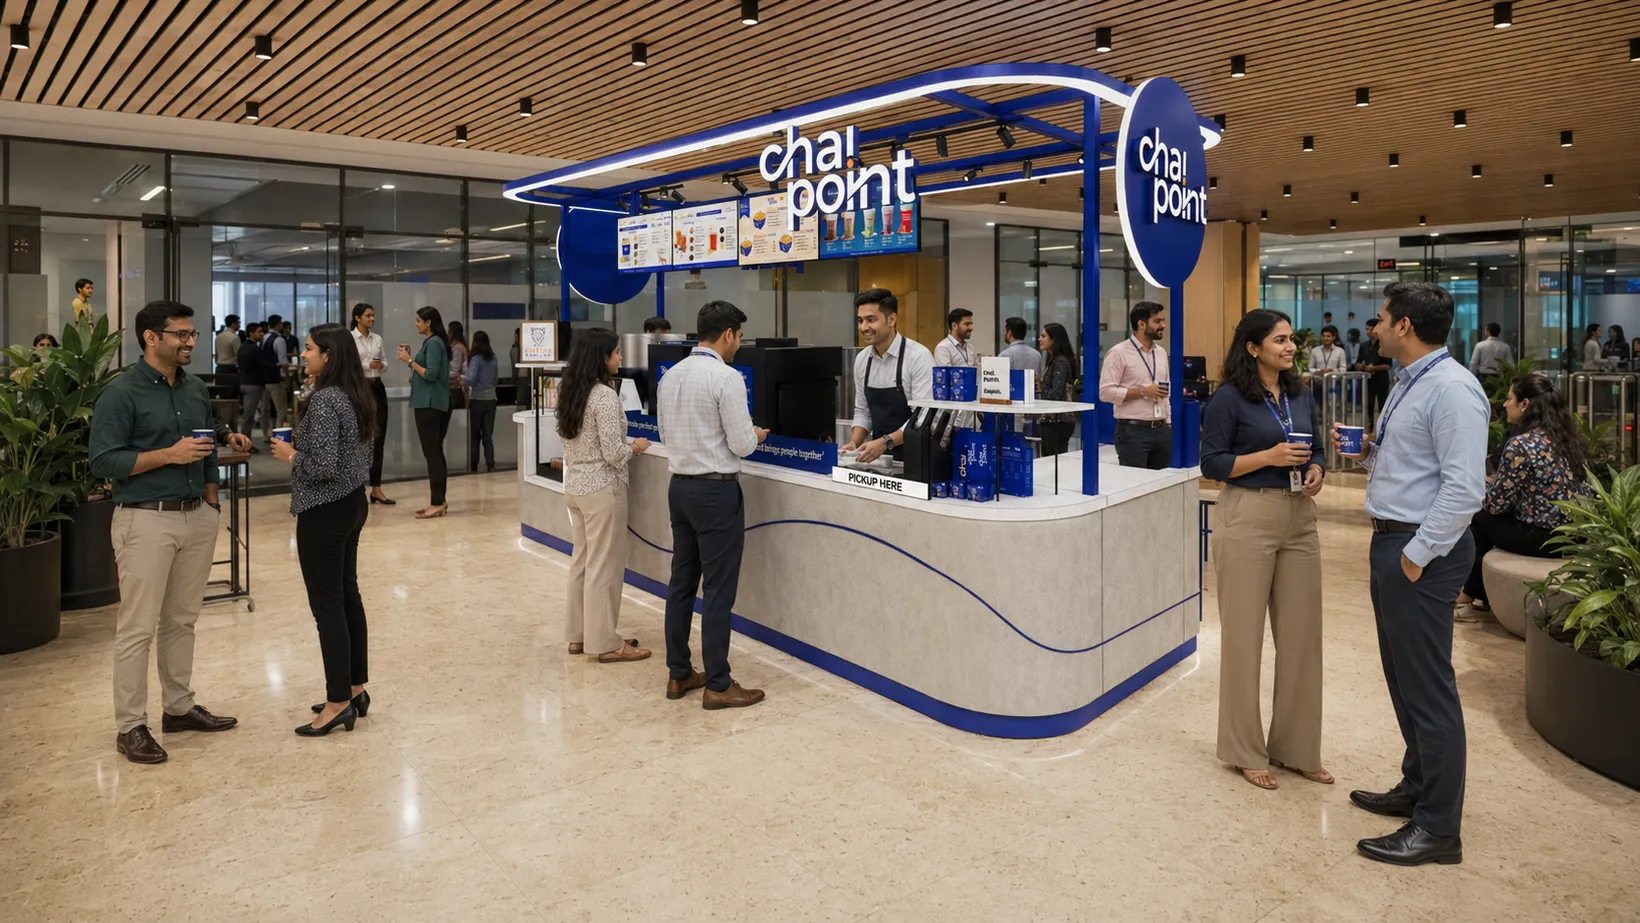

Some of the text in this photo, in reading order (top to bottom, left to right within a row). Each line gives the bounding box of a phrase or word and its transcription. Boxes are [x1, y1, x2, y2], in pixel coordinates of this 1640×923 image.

[788, 150, 916, 231] point
[1153, 185, 1207, 225] point
[848, 472, 903, 492] PICKUP HERE
